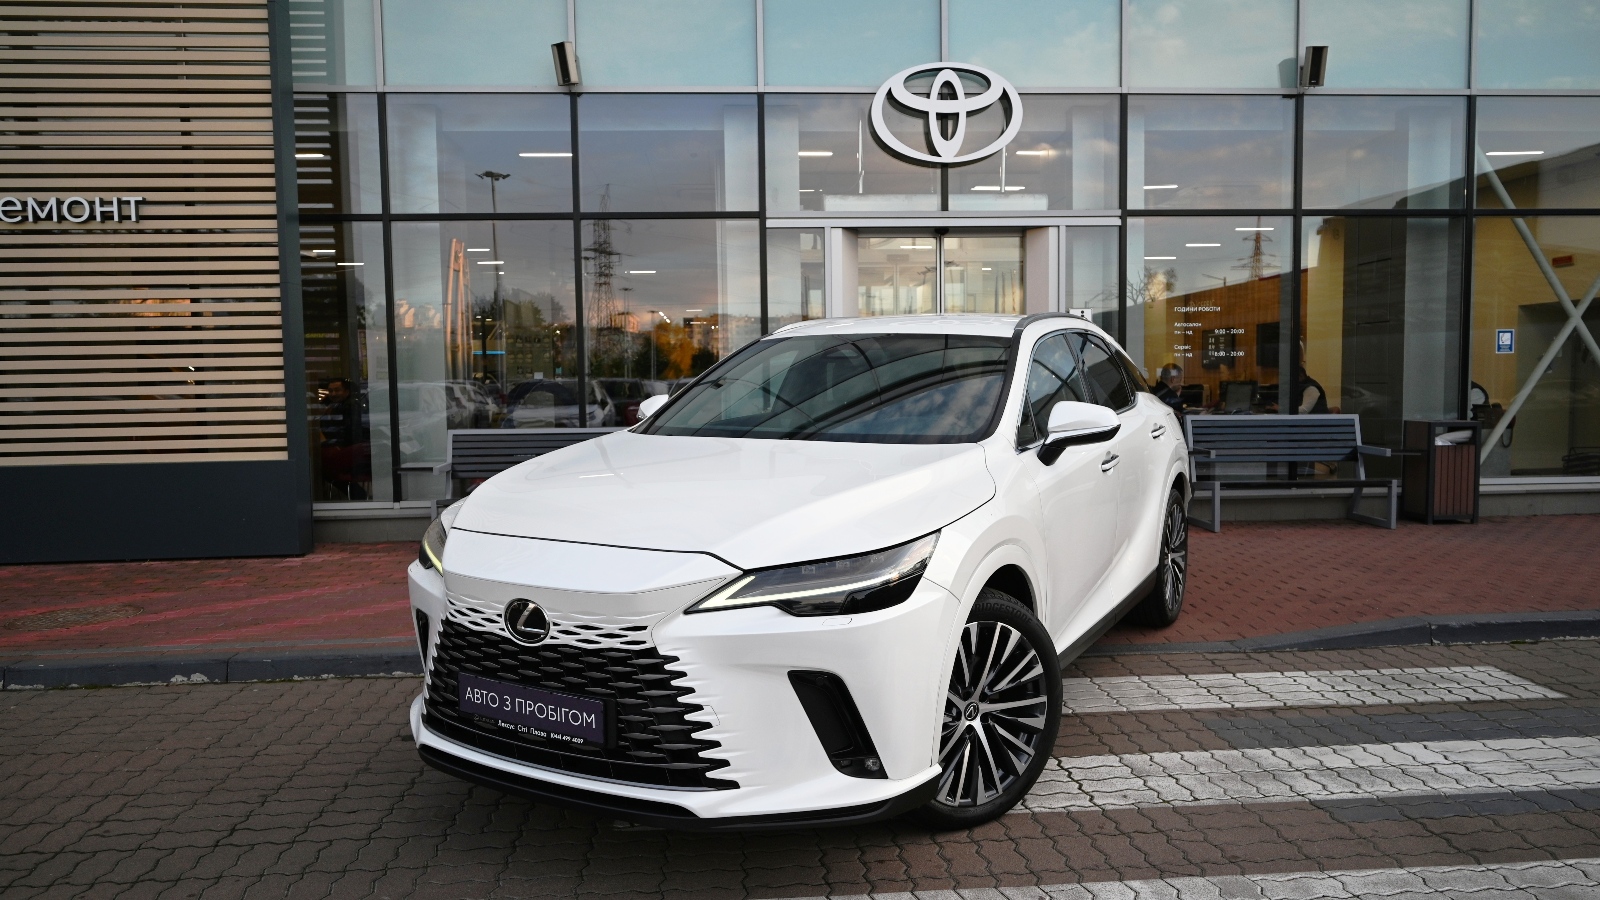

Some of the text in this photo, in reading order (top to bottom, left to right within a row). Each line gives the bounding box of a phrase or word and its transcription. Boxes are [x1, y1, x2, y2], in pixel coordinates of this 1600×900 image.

[0, 196, 143, 223] емонт
[465, 687, 499, 708] АВТО
[515, 698, 596, 729] ПРОБІГОМ
[530, 727, 547, 738] Плаза
